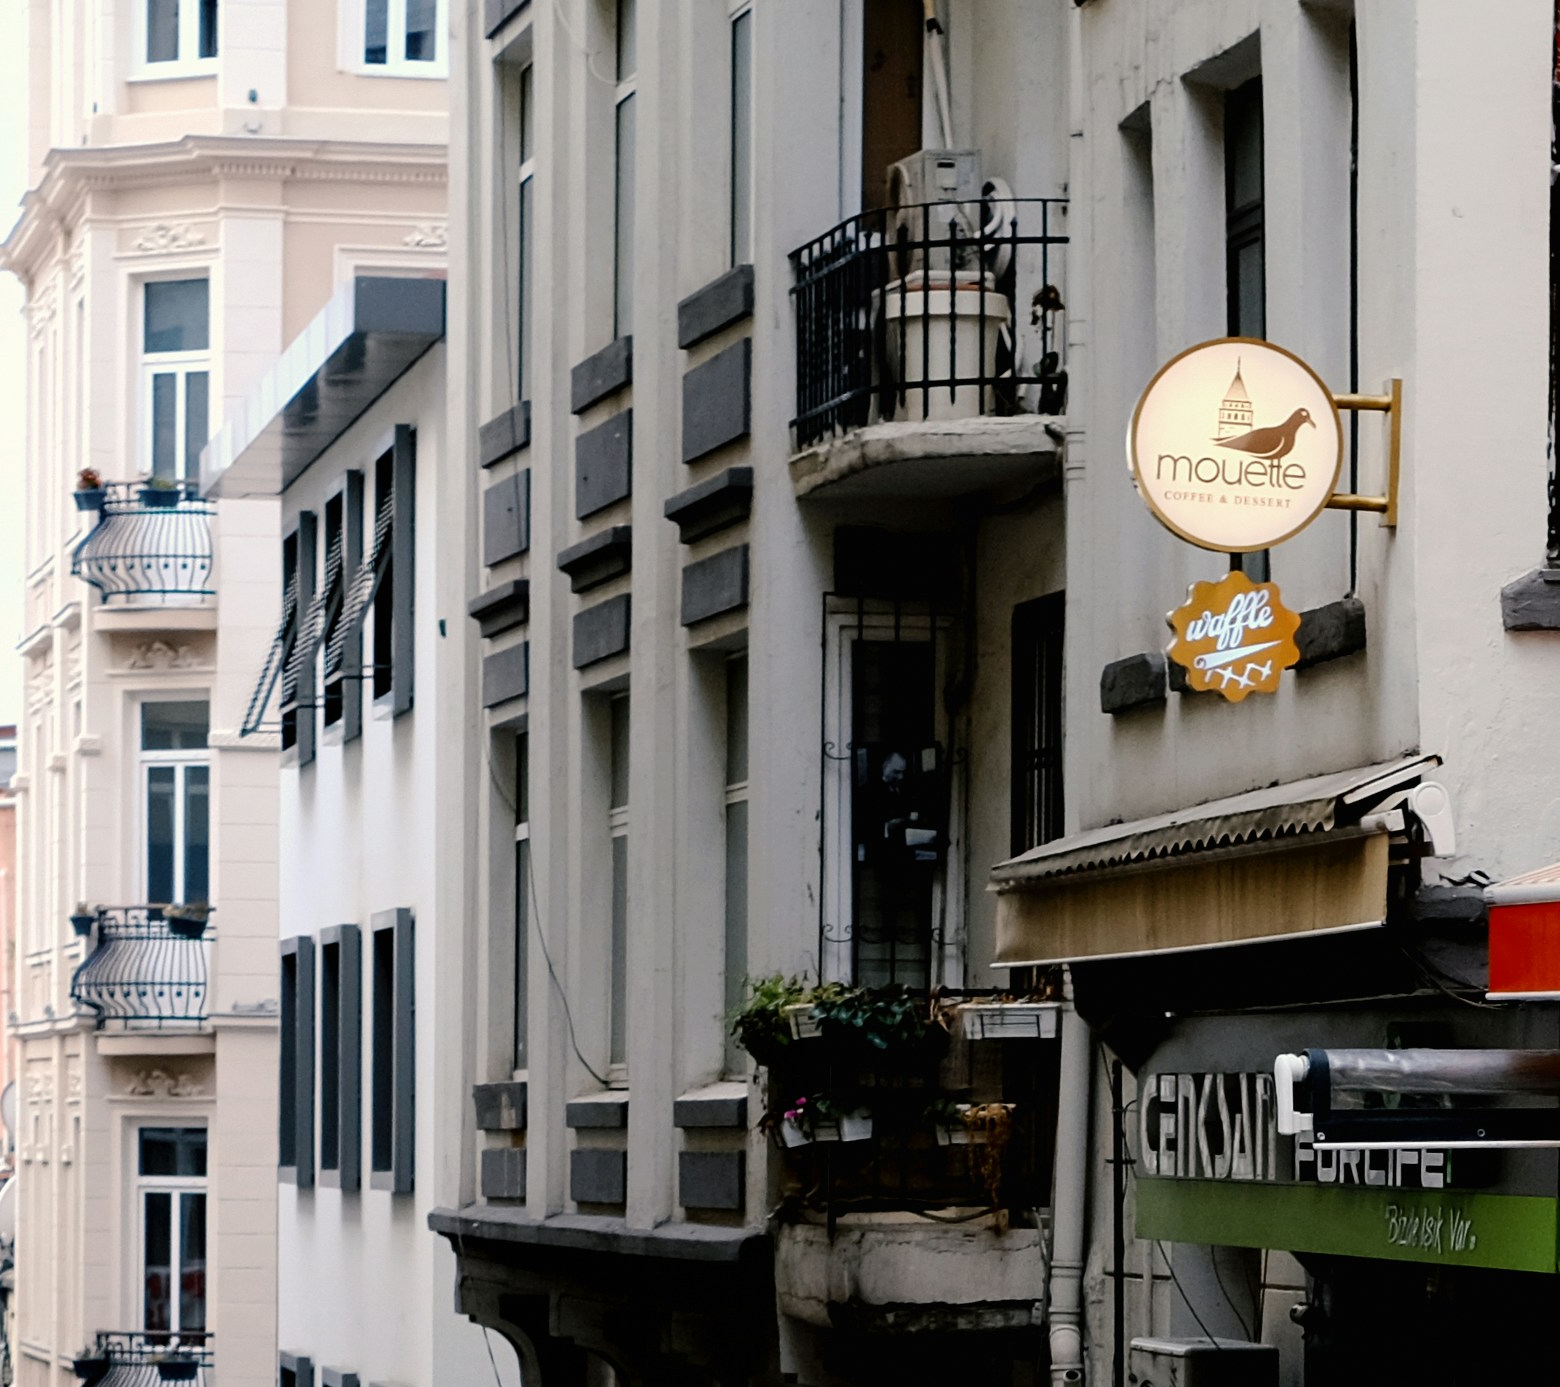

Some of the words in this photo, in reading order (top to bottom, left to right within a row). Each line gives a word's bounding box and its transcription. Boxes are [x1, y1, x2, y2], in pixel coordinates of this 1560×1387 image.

[1156, 453, 1307, 490] mouette
[1164, 490, 1213, 504] COFFEE
[1220, 494, 1227, 504] &
[1235, 496, 1291, 509] DESSERT
[1186, 588, 1274, 650] waffle
